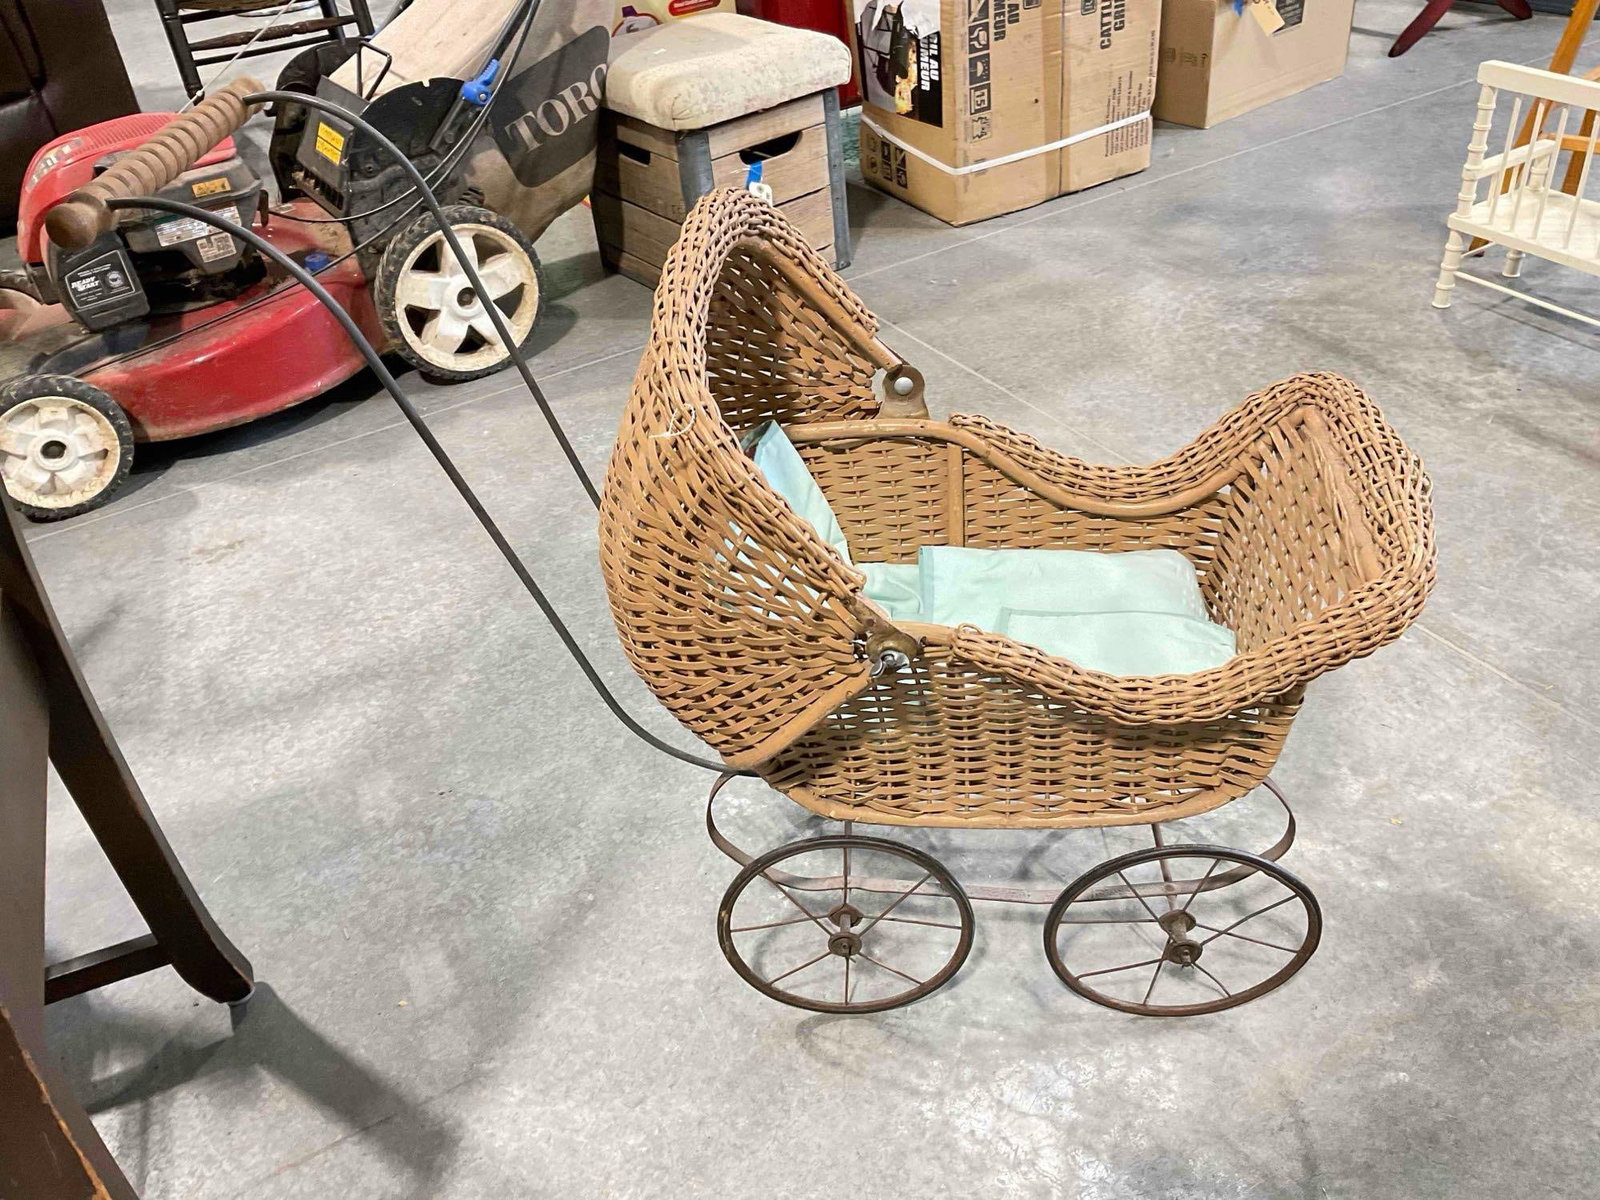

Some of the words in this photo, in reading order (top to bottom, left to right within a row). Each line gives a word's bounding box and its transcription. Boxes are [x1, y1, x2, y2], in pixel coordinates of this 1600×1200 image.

[1100, 0, 1113, 50] CATTL
[919, 36, 931, 91] UMEUR
[504, 63, 608, 154] TORO
[70, 276, 97, 289] READY
